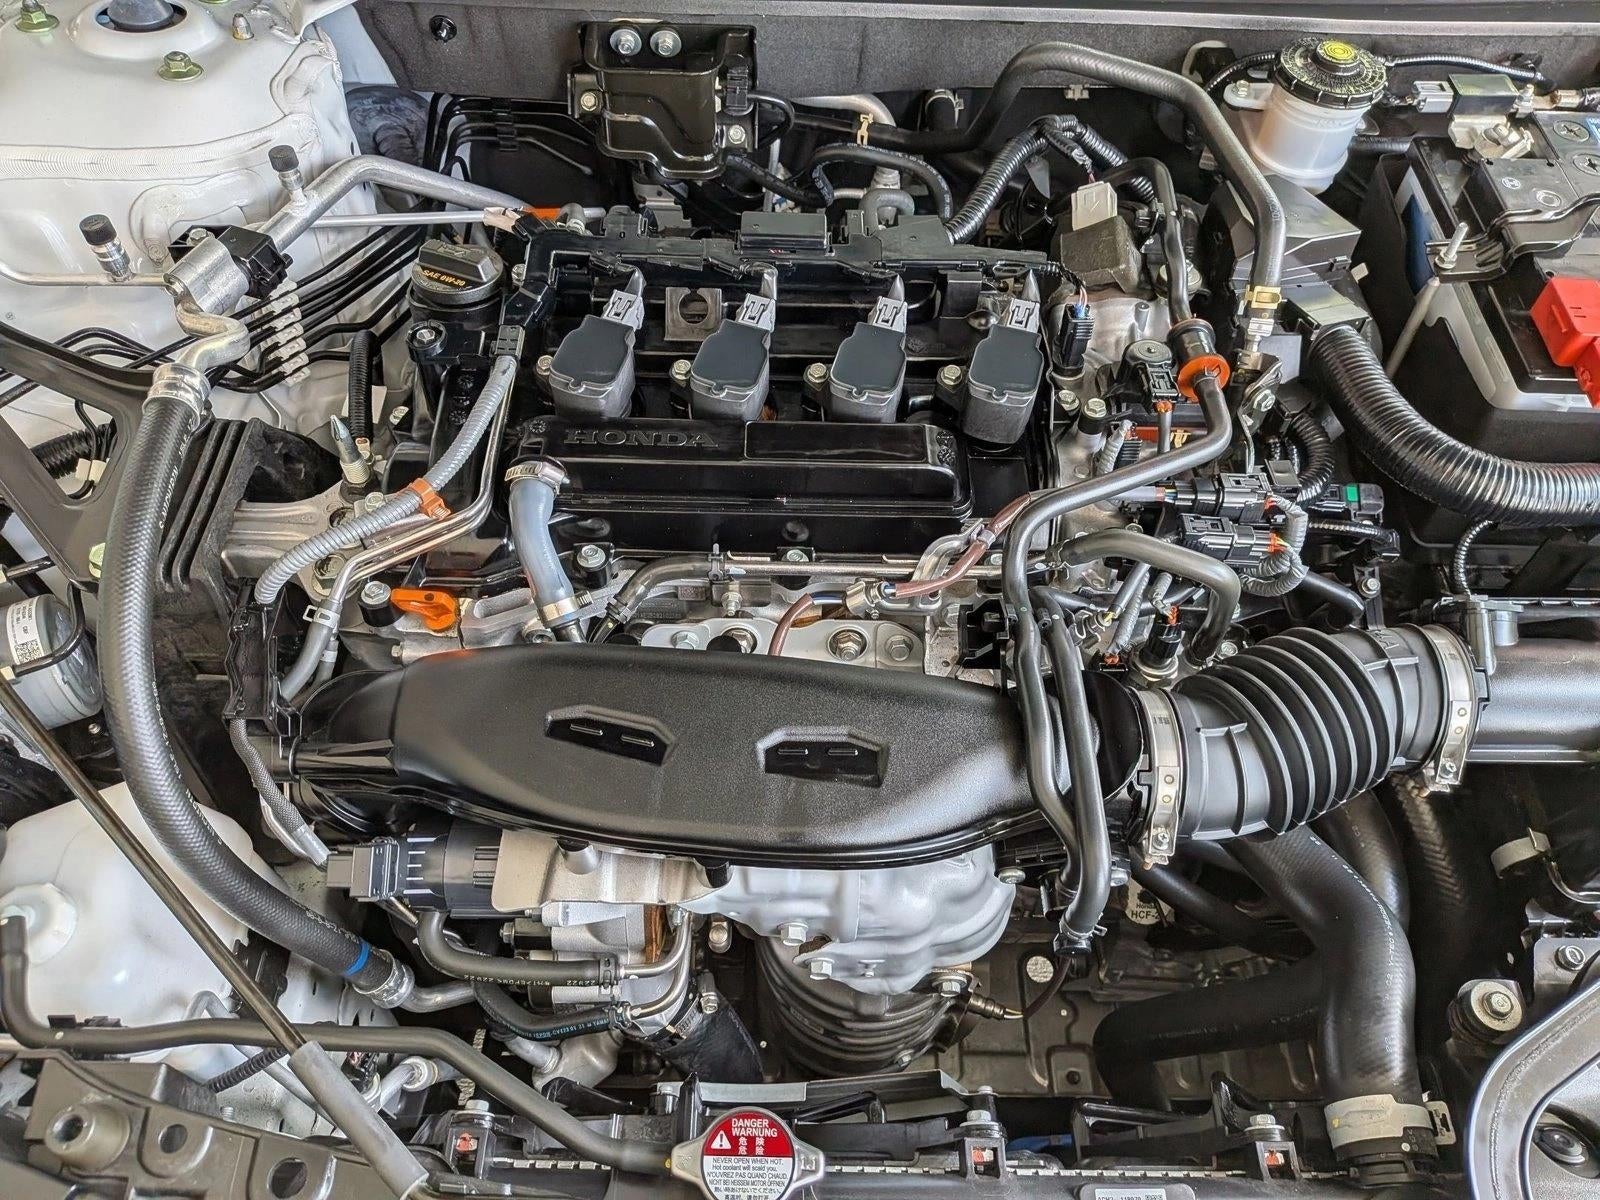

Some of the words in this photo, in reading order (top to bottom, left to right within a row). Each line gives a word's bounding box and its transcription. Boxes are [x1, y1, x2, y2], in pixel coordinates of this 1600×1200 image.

[422, 270, 441, 279] SAE
[440, 275, 466, 286] 0W-20
[564, 430, 718, 447] HONDA
[1131, 910, 1160, 919] HCF-2
[732, 1118, 769, 1128] DANGER
[732, 1127, 778, 1138] WARNUNG
